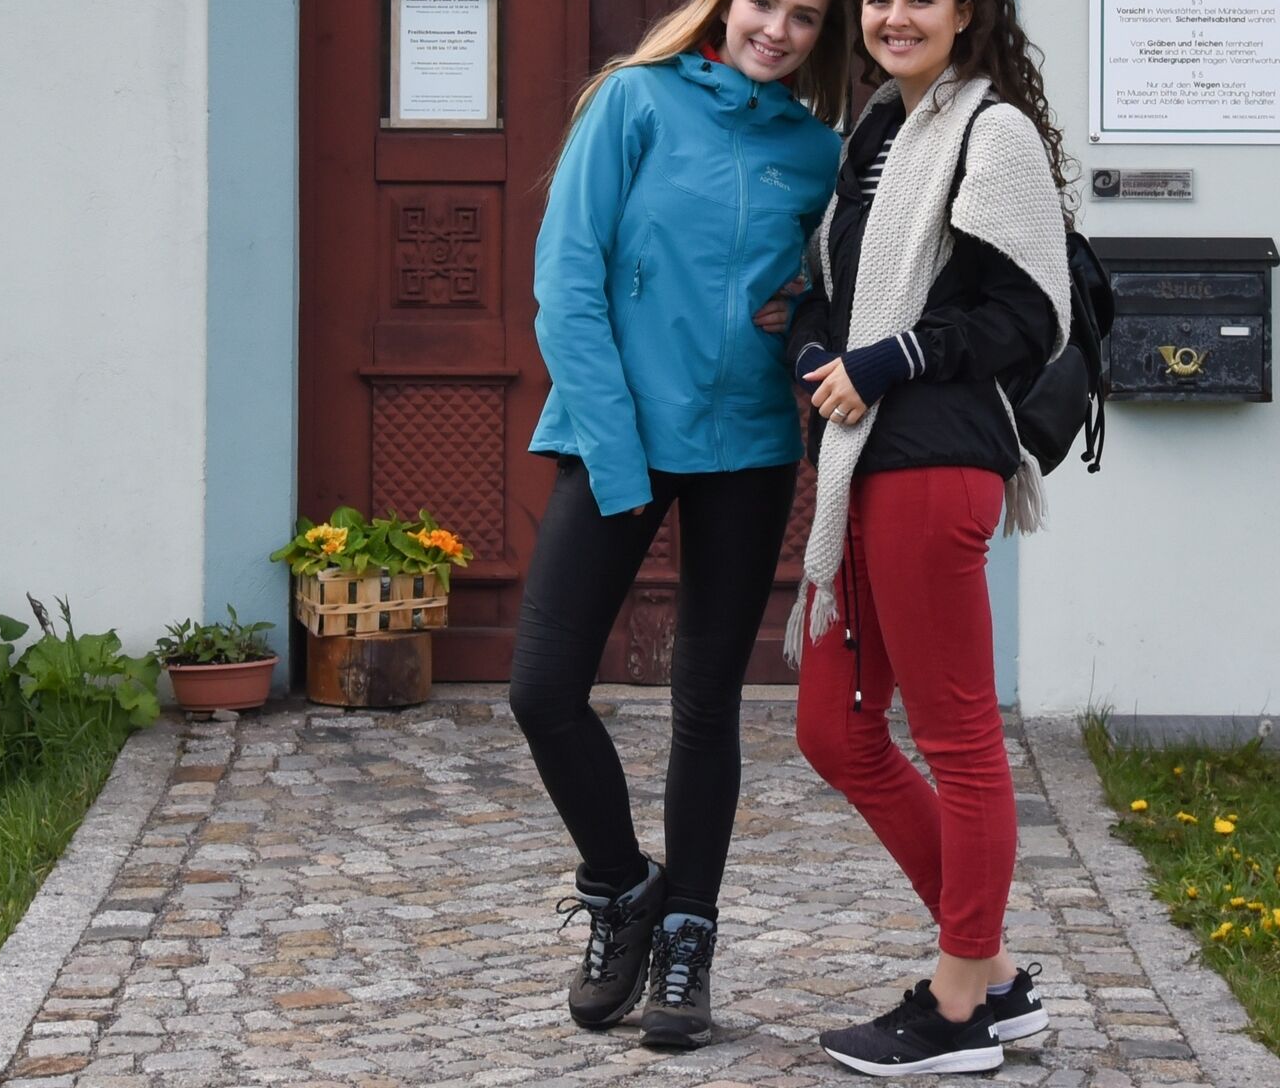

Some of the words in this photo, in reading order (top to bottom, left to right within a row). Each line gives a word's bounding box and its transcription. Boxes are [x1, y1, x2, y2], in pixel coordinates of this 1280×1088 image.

[1147, 57, 1200, 65] Kindergruppen
[1193, 81, 1220, 89] Wegen
[1217, 90, 1250, 98] Ordnung
[1116, 98, 1139, 106] Papier
